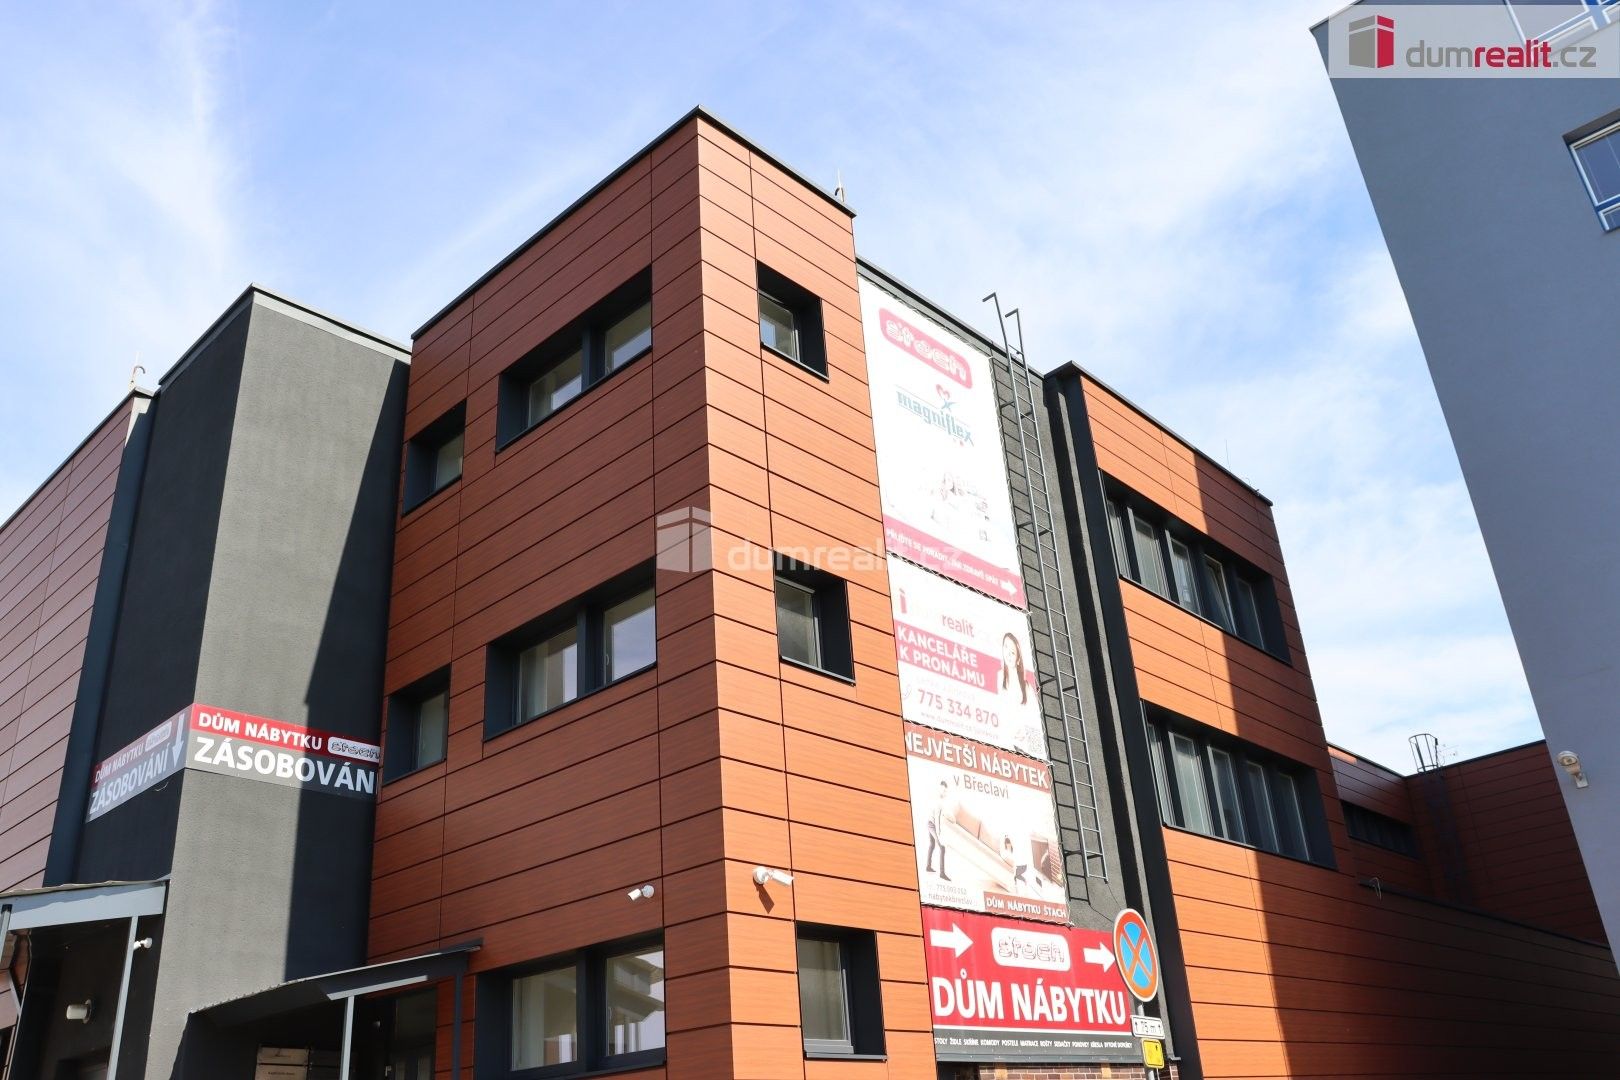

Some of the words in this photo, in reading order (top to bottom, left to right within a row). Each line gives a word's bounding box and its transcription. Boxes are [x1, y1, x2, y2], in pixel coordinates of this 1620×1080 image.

[896, 390, 975, 447] magniflex
[897, 625, 979, 668] KANCELÁŘE
[900, 645, 910, 661] K
[913, 651, 986, 687] PRONÁJMU
[918, 688, 944, 710] 775
[947, 698, 972, 719] 334
[975, 707, 999, 728] 870
[199, 711, 241, 735] DŮM
[245, 720, 323, 751] NÁBYTKU
[89, 741, 171, 815] ZÁSOBOVÁNÍ
[94, 762, 112, 784] DŮM
[112, 742, 145, 772] NÁBYTKU
[194, 736, 378, 796] ZÁSOBOVÁN
[905, 730, 978, 769] NEJVĚTŠÍ
[980, 750, 1049, 790] NÁBYTEK
[953, 774, 960, 787] v
[964, 774, 1010, 799] Břeclavi
[986, 895, 1005, 909] DŮM
[1007, 898, 1041, 915] NÁBYTKU
[1043, 904, 1067, 919] ŠTACH
[931, 967, 1005, 1020] DŮM
[1010, 976, 1127, 1026] NÁBYTKU
